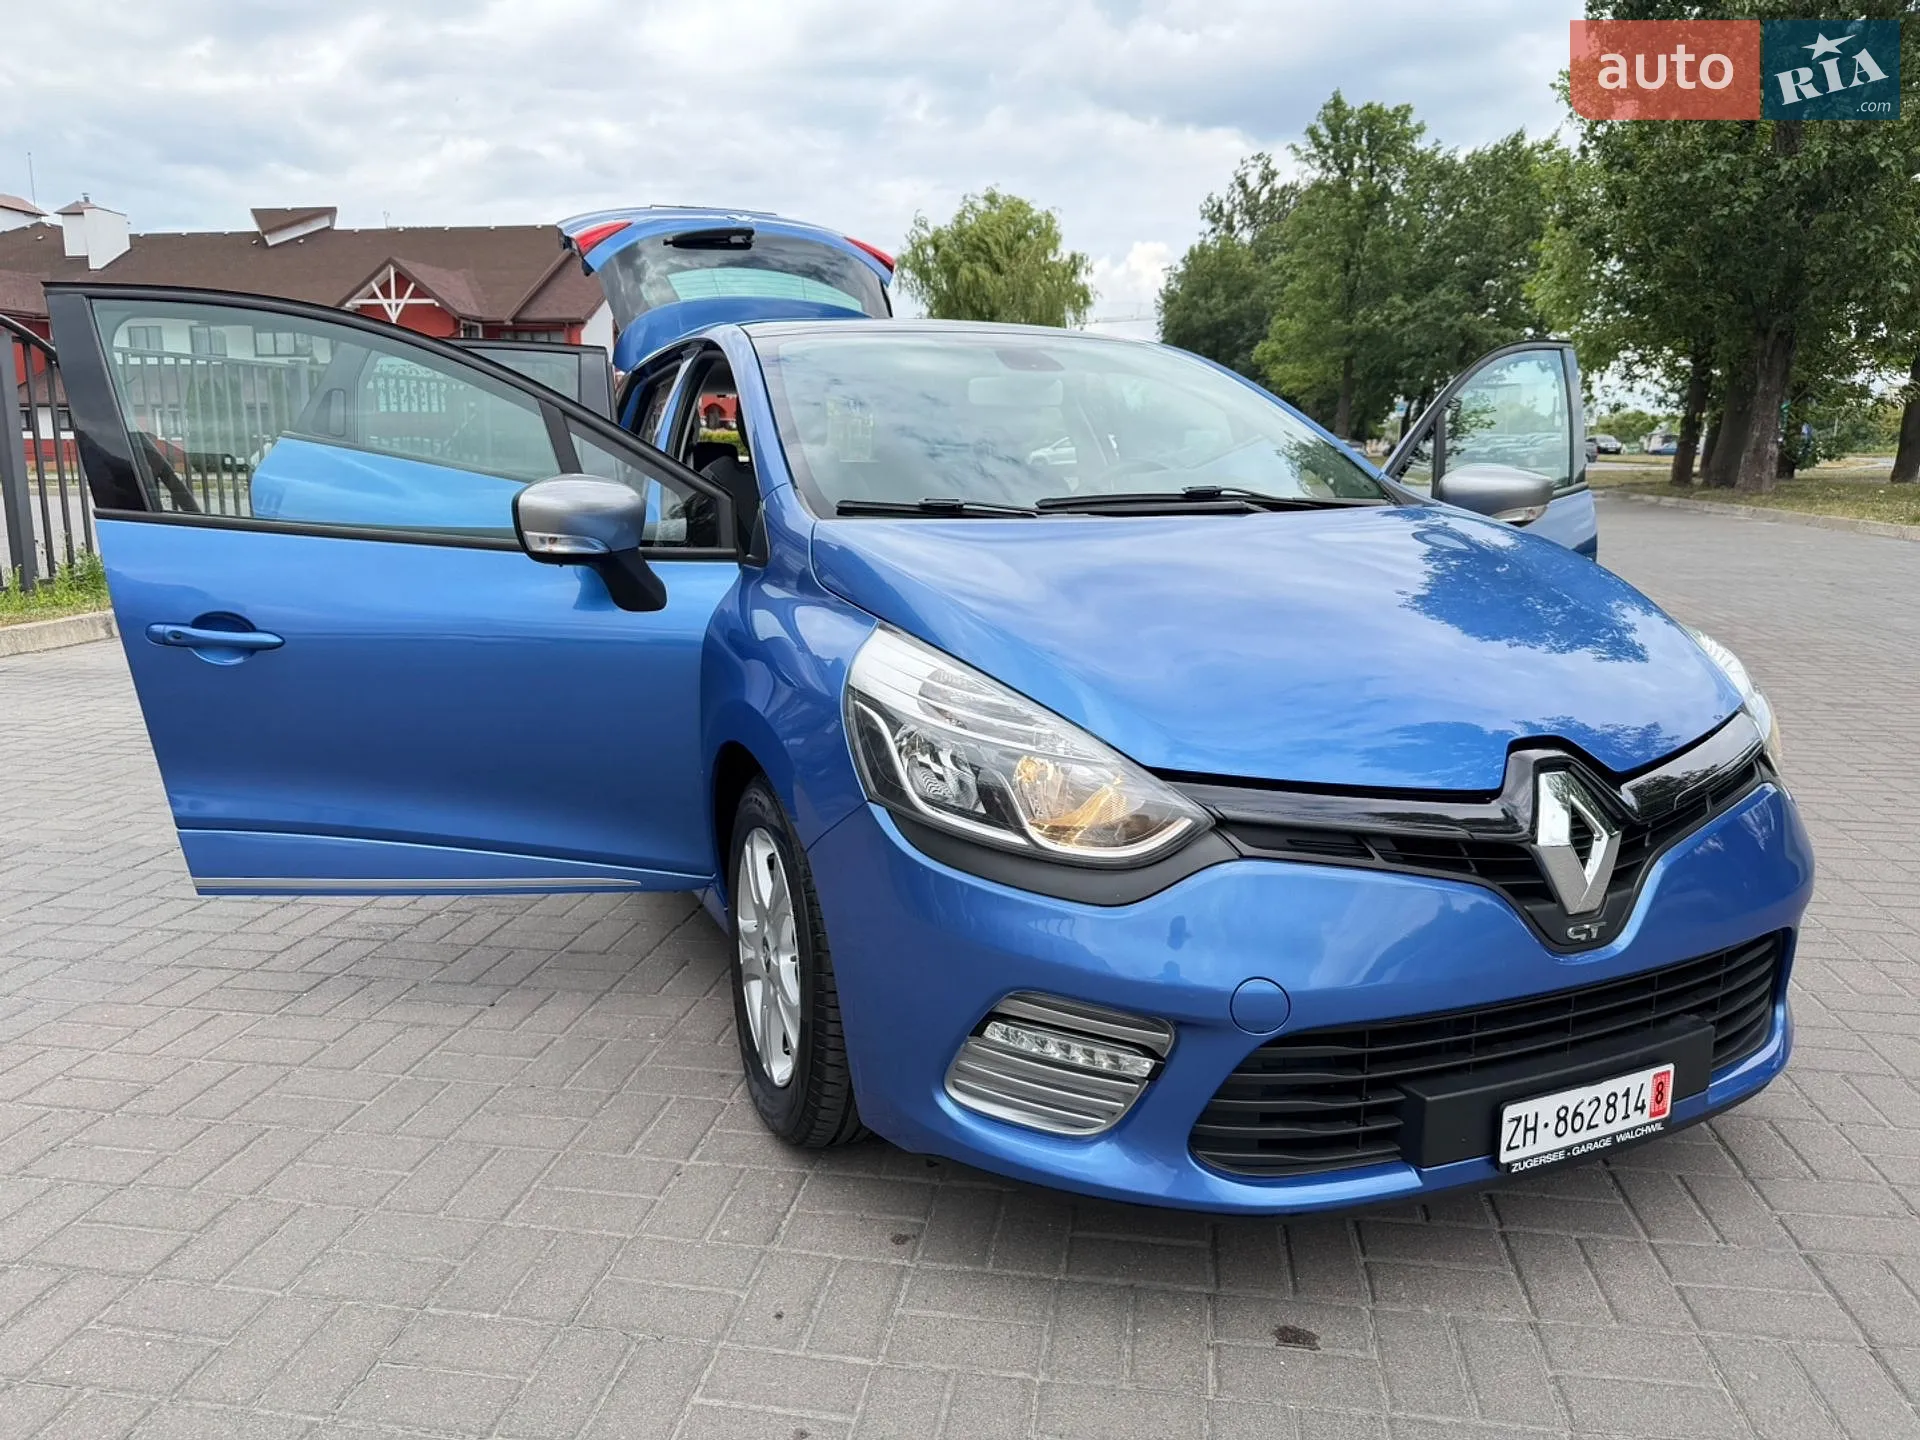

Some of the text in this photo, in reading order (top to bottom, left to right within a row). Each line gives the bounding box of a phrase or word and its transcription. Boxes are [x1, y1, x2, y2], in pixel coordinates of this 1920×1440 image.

[1566, 921, 1608, 941] GT
[1654, 1081, 1665, 1105] 8
[1615, 1121, 1665, 1144] WALCHWIL
